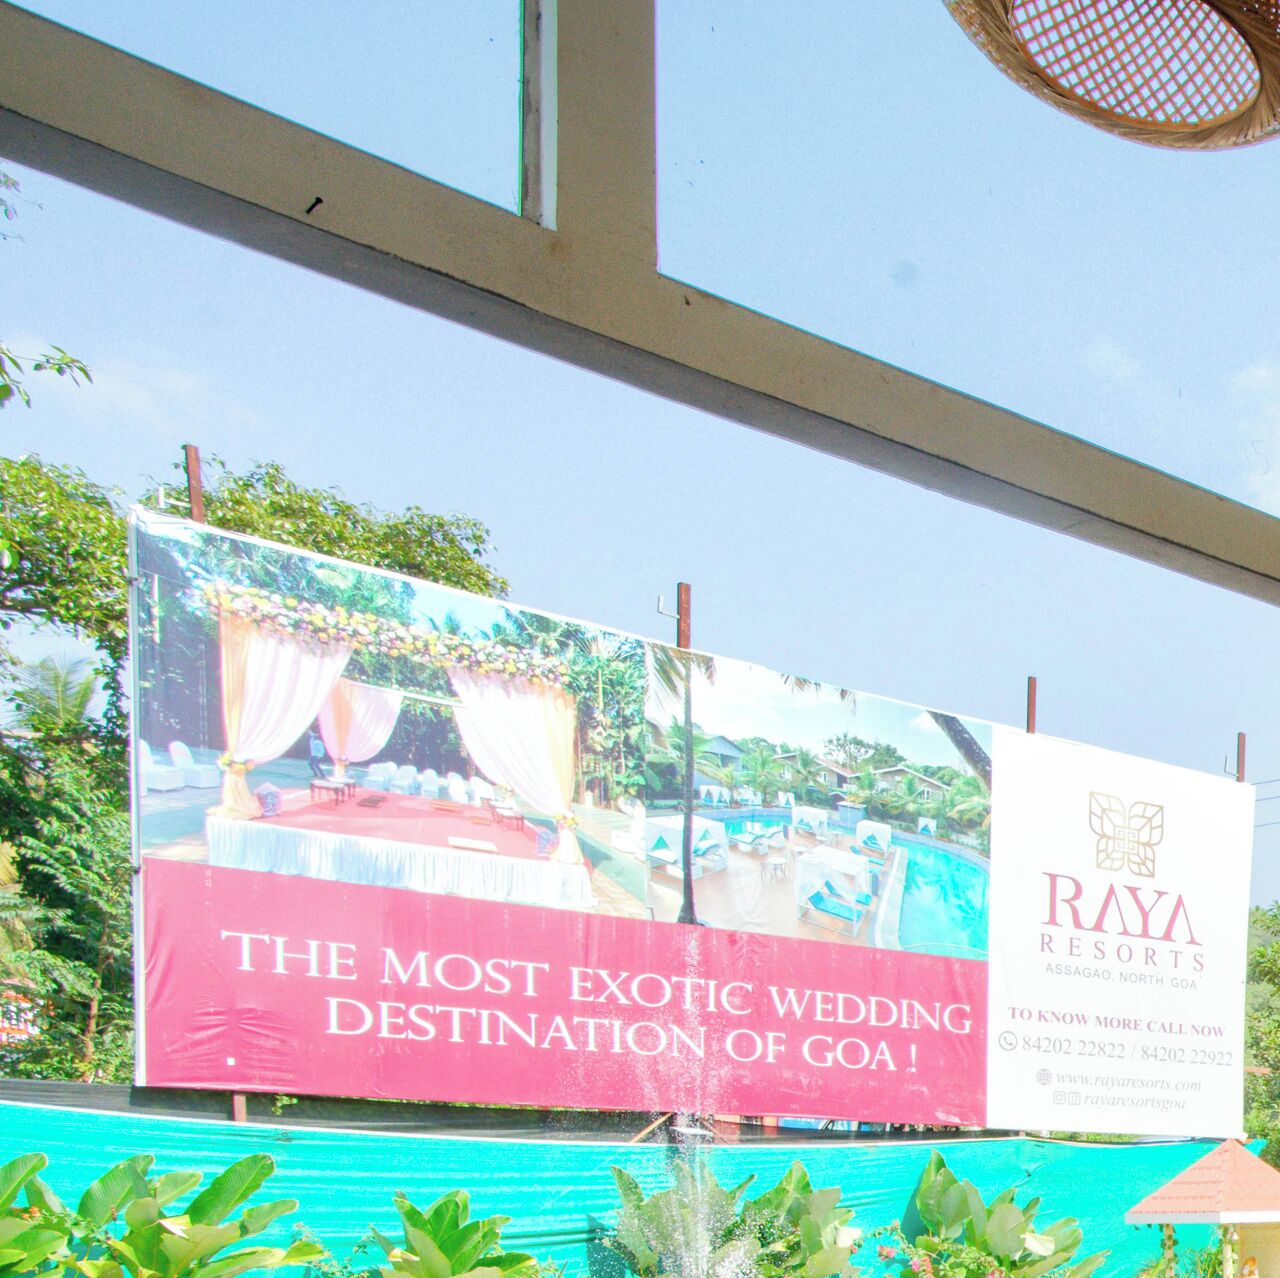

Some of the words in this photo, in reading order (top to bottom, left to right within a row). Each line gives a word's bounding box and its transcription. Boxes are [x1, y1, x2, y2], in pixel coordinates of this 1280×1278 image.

[1041, 872, 1203, 946] RAYA
[1040, 933, 1205, 972] RESORTS
[221, 930, 358, 981] THE
[380, 947, 550, 997] MOST
[568, 966, 754, 1015] EXOTIC
[768, 986, 974, 1035] WEDDING
[1119, 972, 1164, 987] NORTH
[1171, 978, 1198, 991] GOA
[325, 996, 705, 1058] DESTINATION
[725, 1029, 787, 1064] OF
[801, 1036, 897, 1072] GOA
[1008, 1007, 1033, 1021] TO
[1037, 1010, 1089, 1026] KNOW
[1095, 1016, 1143, 1032] MORE
[1147, 1020, 1187, 1035] CALL
[1191, 1024, 1227, 1037] NOW
[1022, 1036, 1072, 1054] 84202
[1078, 1041, 1126, 1059] 22822
[1140, 1045, 1186, 1063] 84202
[1189, 1049, 1233, 1067] 22922
[1056, 1072, 1201, 1092] www.rayaresorts.com
